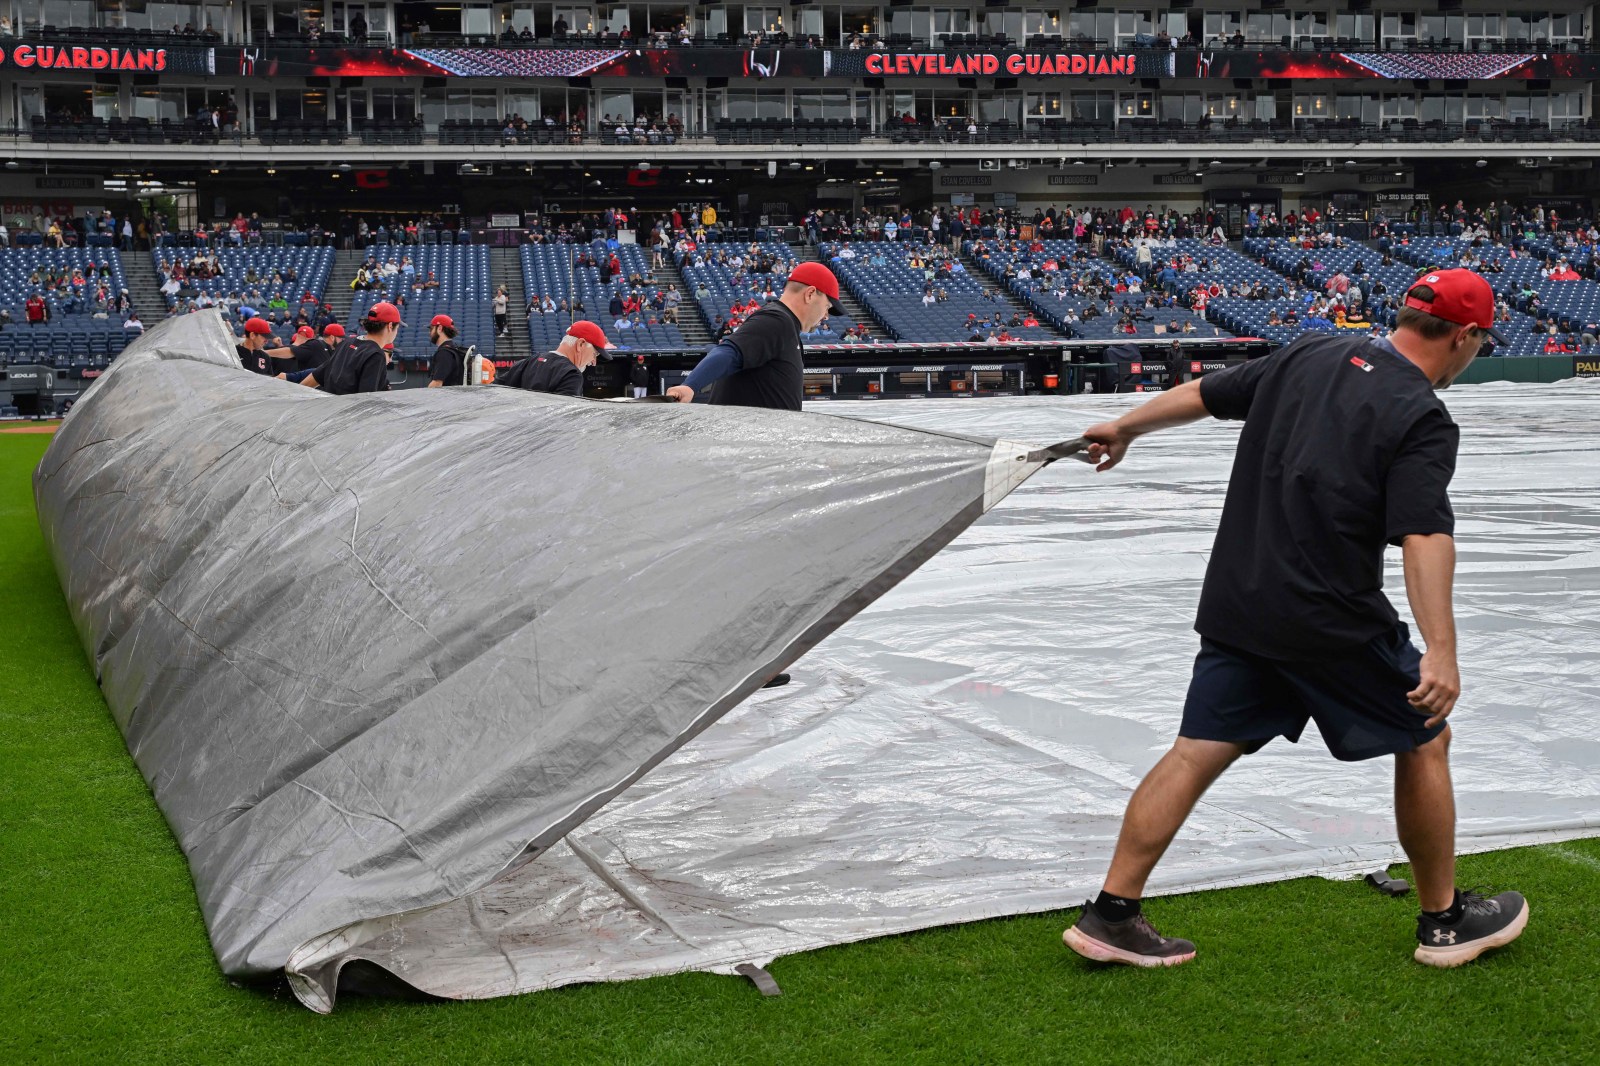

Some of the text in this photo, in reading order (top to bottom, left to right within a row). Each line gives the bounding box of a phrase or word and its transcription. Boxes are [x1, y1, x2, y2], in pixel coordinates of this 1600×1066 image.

[13, 45, 166, 70] GUARDIANS
[865, 53, 1136, 75] CLEVELAND GUARDIANS
[942, 176, 991, 185] STAN COVELESKI
[1051, 175, 1063, 184] LOU
[1161, 175, 1194, 184] BOB LEMON
[1264, 175, 1282, 184] LARRY
[1365, 175, 1383, 183] EARLY
